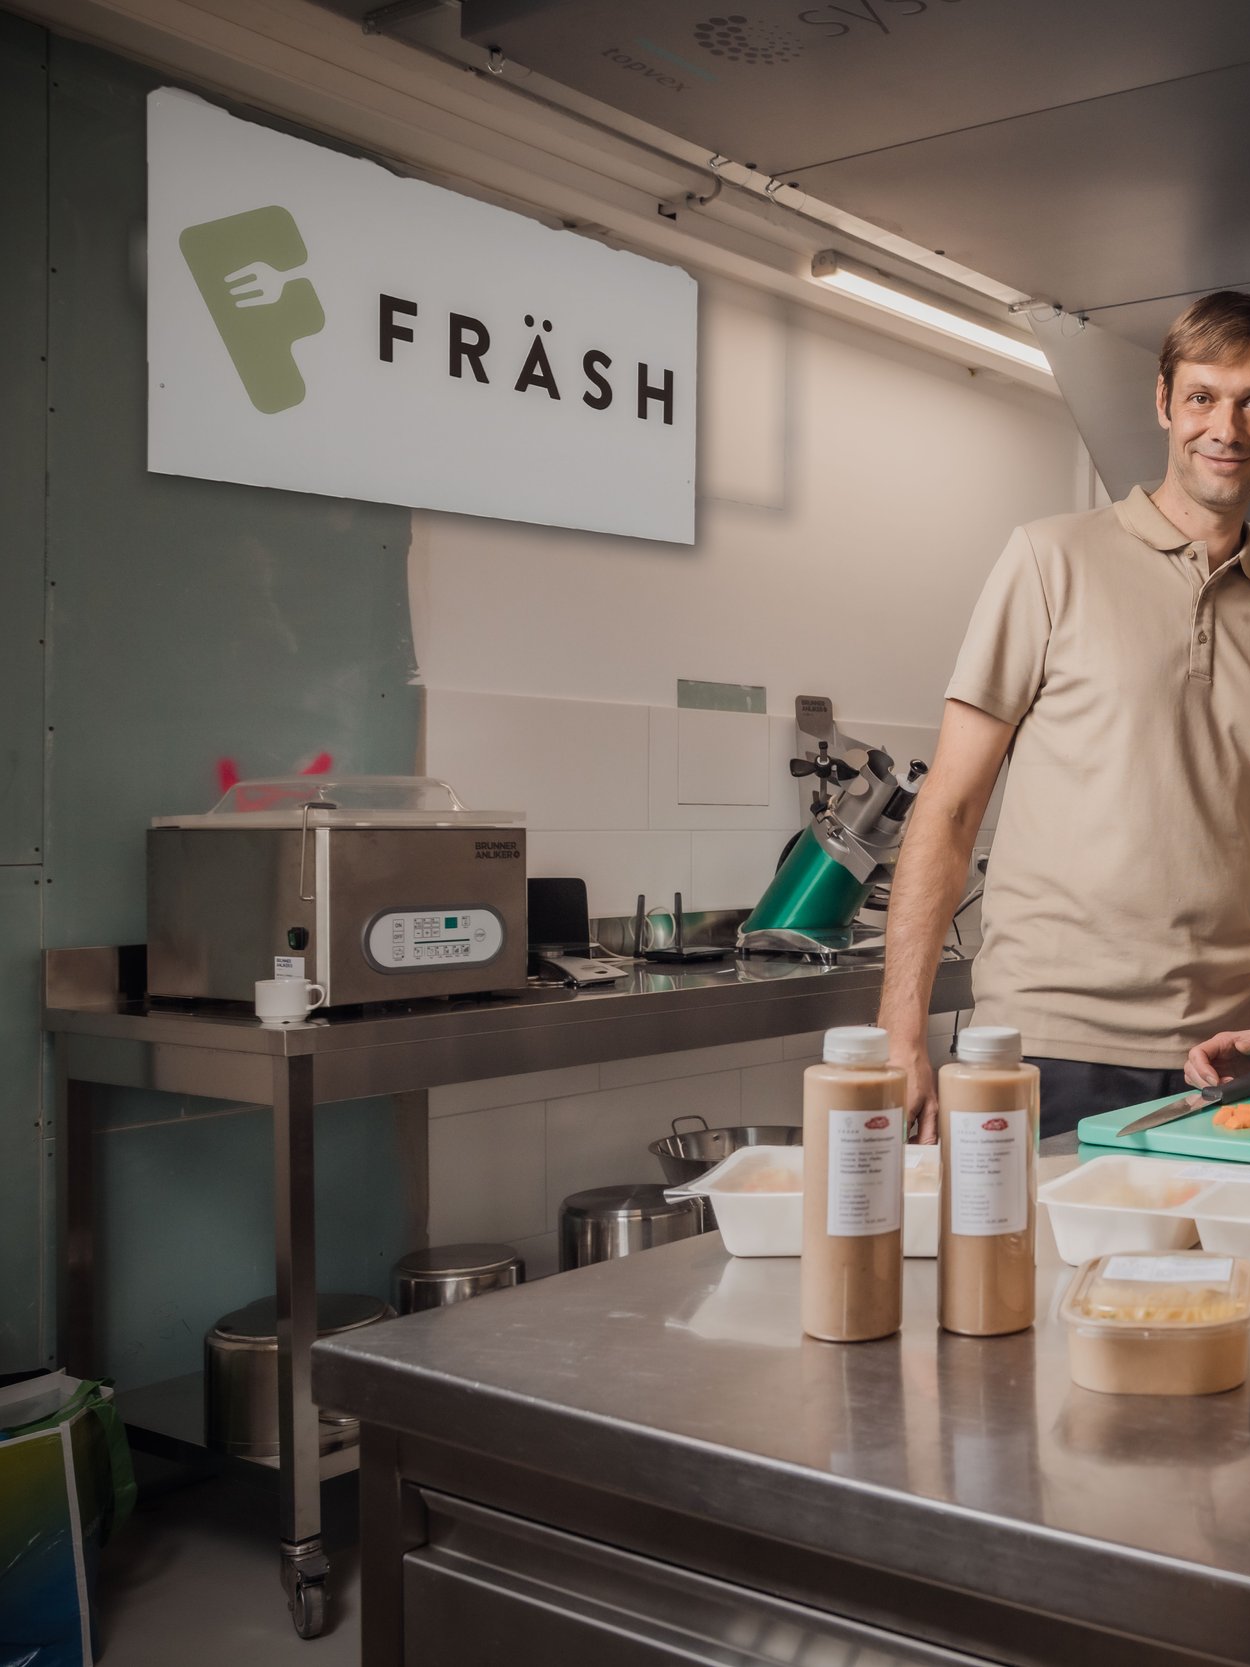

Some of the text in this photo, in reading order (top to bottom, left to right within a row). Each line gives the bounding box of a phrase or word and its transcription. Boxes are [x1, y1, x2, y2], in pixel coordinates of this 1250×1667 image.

[601, 46, 691, 93] topvex
[379, 293, 674, 426] FRÄSH
[475, 841, 517, 850] BRUNNER
[475, 850, 513, 859] ANLIKER
